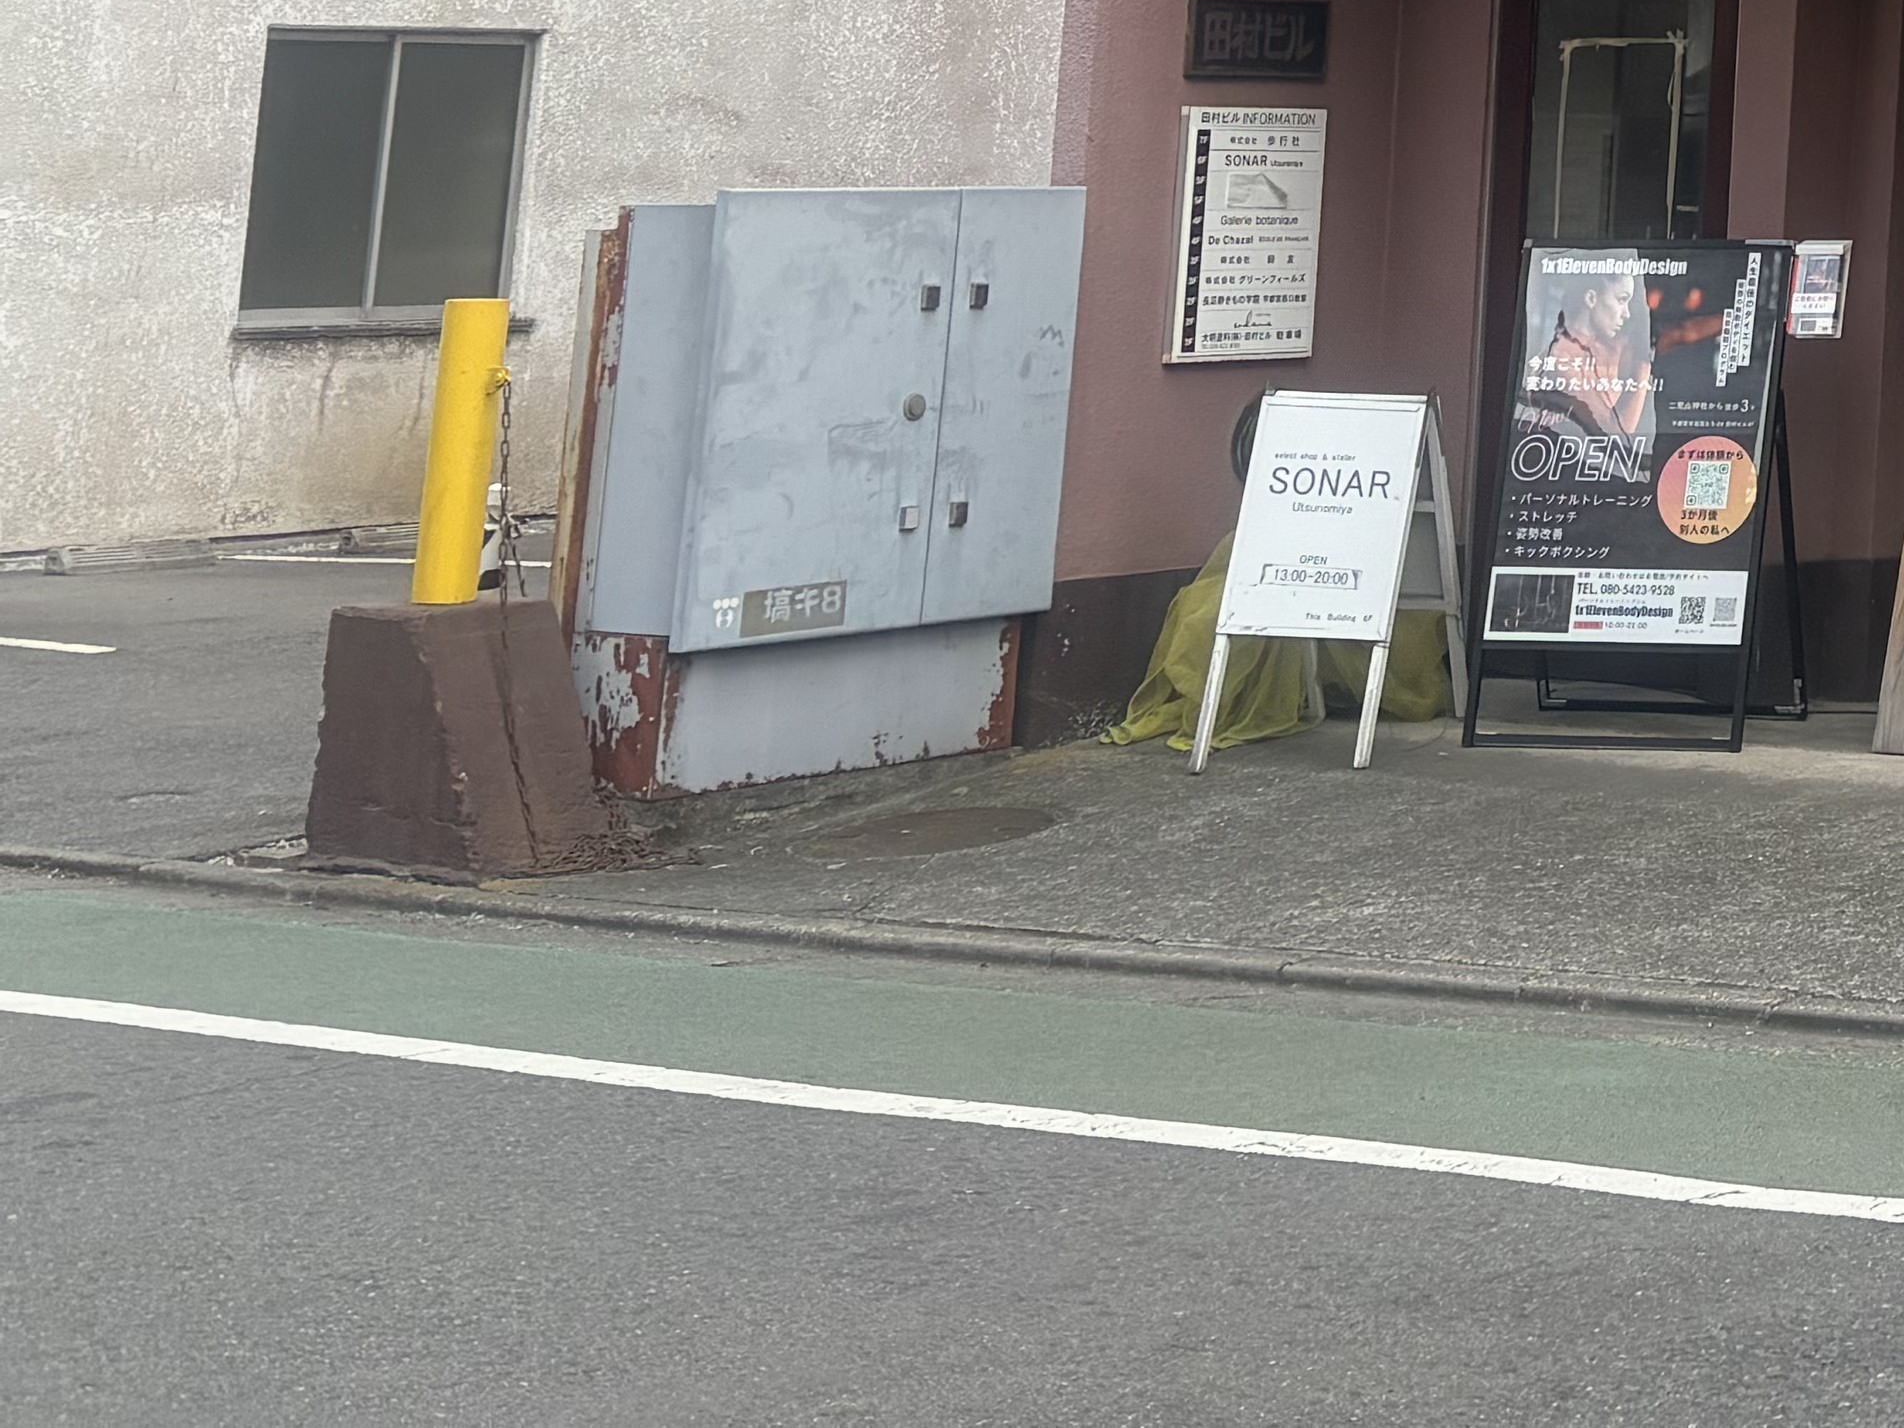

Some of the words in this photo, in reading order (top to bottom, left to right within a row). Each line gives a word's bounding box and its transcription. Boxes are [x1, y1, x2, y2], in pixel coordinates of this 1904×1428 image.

[1202, 10, 1317, 62] 田村ビル
[1201, 111, 1241, 124] 田村ビル
[1242, 111, 1317, 126] INFORMATION
[1224, 154, 1268, 167] SONAR
[1511, 434, 1647, 483] OPEN
[1268, 466, 1392, 500] SONAR
[1292, 502, 1353, 515] Utsunomiya
[1299, 554, 1329, 565] OPEN
